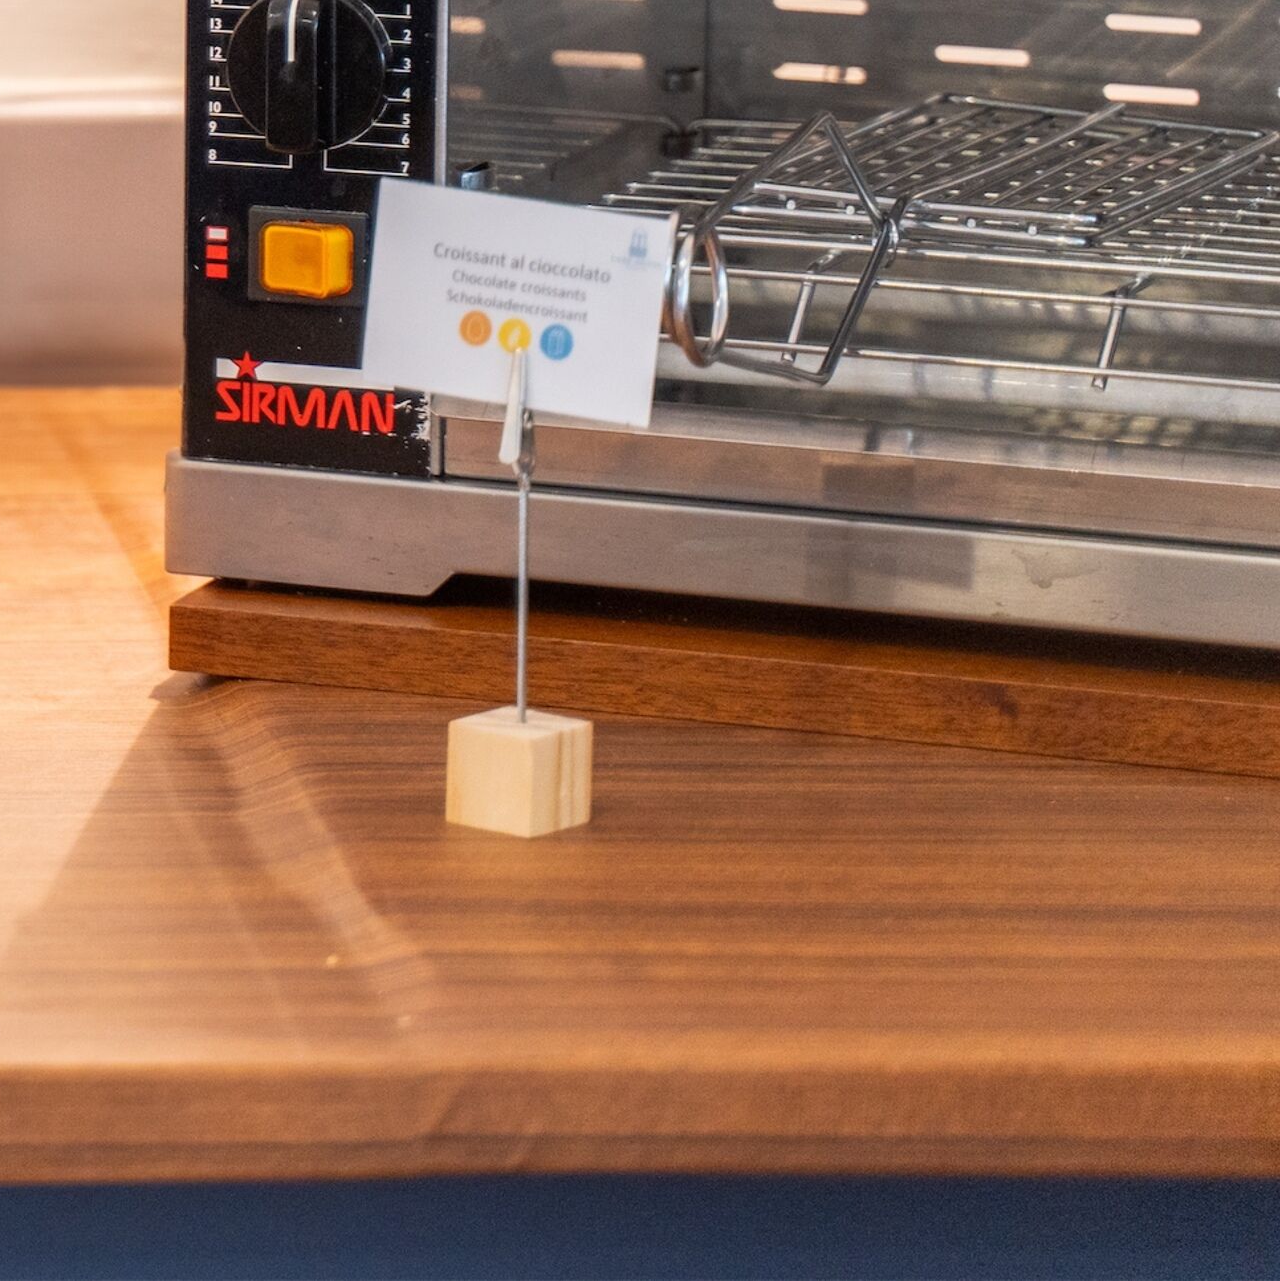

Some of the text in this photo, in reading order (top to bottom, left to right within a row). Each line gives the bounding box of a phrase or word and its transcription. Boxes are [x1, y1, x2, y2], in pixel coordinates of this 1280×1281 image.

[406, 4, 411, 16] 1
[210, 18, 223, 31] 13
[404, 29, 412, 41] 2
[210, 47, 222, 59] 12
[403, 58, 412, 70] 3
[209, 76, 220, 89] 11
[402, 87, 411, 100] 4
[209, 101, 221, 113] 10
[403, 113, 411, 126] 5
[208, 121, 217, 134] 9
[402, 133, 410, 145] 6
[208, 149, 217, 161] 8
[402, 162, 410, 174] 7
[433, 241, 506, 270] Croissant
[510, 254, 526, 271] al
[528, 258, 612, 285] cioccolato
[452, 268, 587, 303] Chocolate croissants
[445, 289, 589, 324] Schokoladencroissant
[215, 380, 395, 436] SIRMAN
